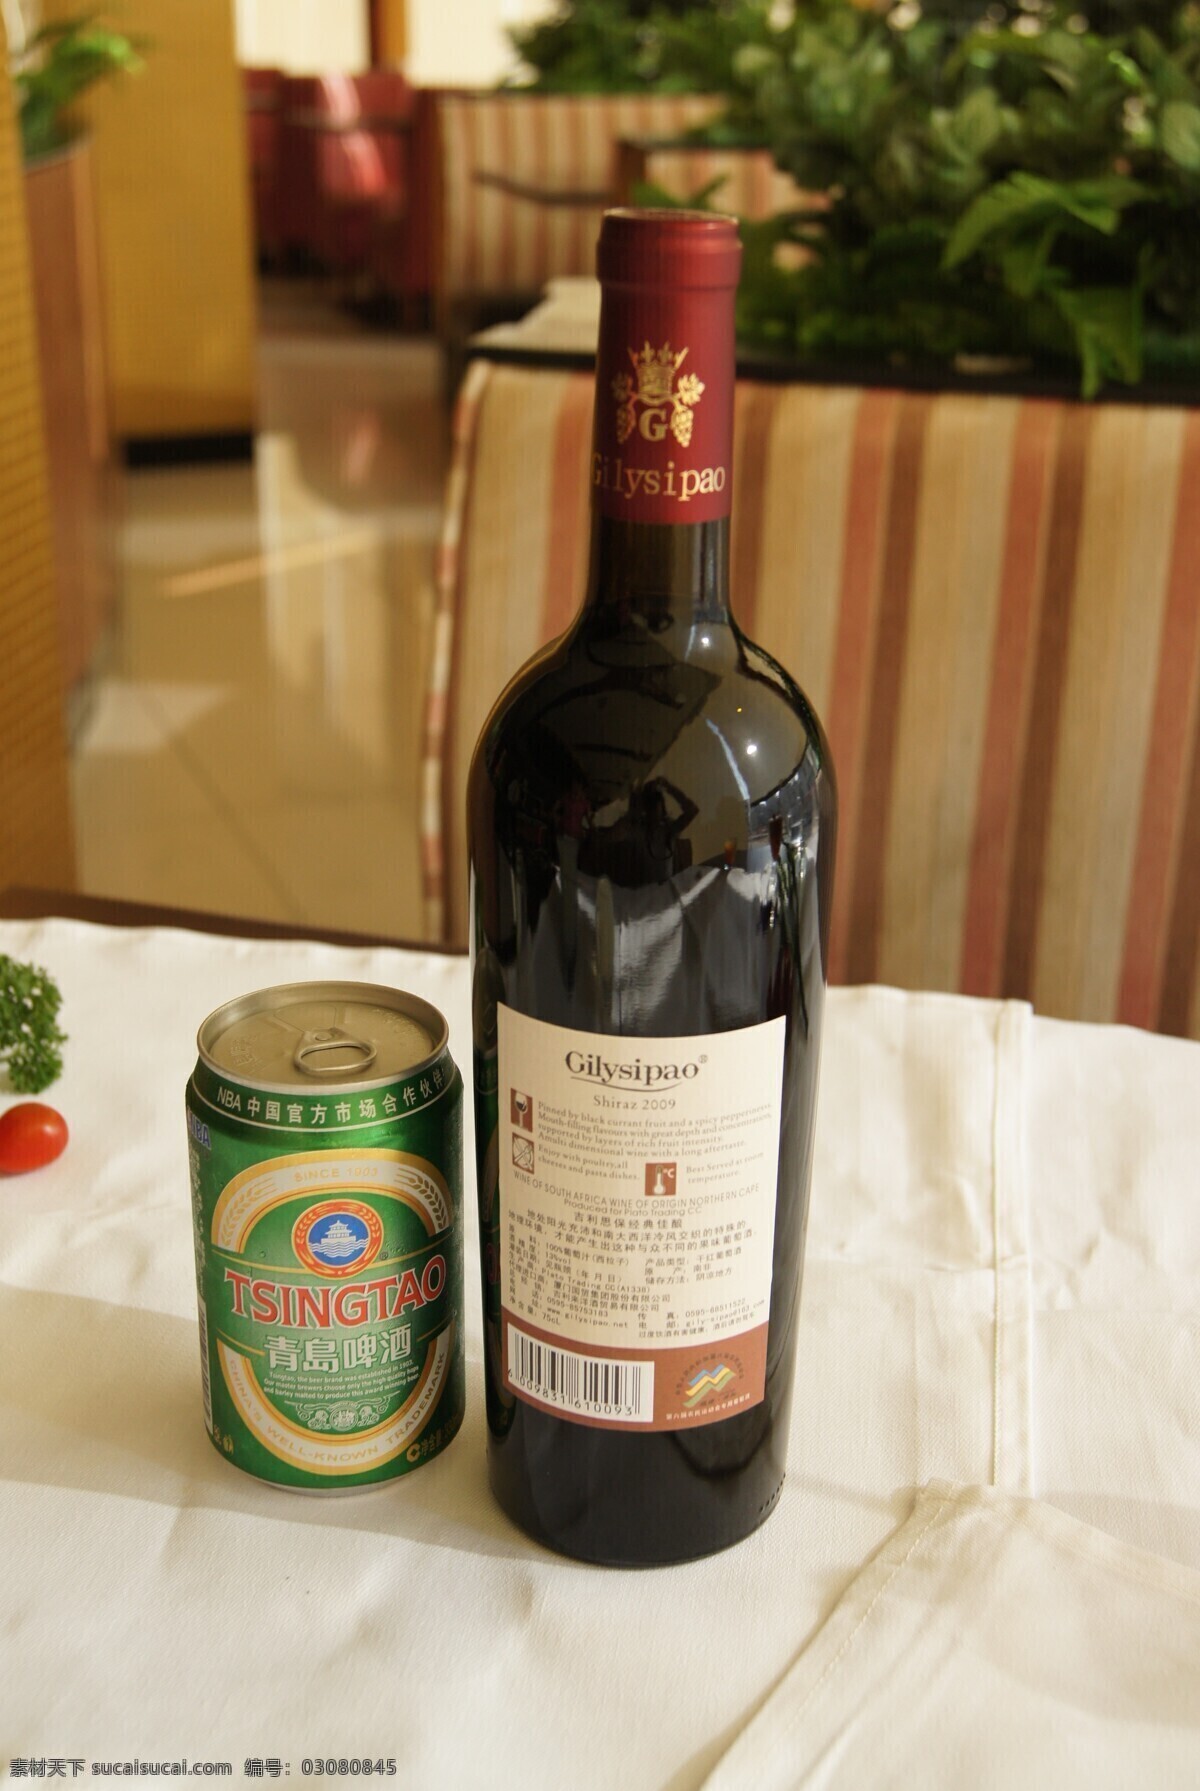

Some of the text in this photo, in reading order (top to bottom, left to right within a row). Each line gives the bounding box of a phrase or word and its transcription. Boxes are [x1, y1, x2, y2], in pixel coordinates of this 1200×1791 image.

[639, 408, 668, 442] G
[565, 1051, 699, 1085] Gilysipao
[217, 1086, 241, 1111] NBA
[593, 1095, 676, 1111] Shiraz 2009
[538, 1112, 591, 1134] Mouth-filling
[593, 1125, 628, 1137] flavours
[630, 1129, 650, 1137] with
[651, 1130, 675, 1139] great
[676, 1128, 700, 1139] depth
[703, 1126, 717, 1135] and
[568, 1110, 579, 1121] by
[581, 1112, 604, 1124] black
[607, 1118, 642, 1127] currant
[645, 1119, 667, 1128] fruit
[669, 1118, 686, 1127] and
[695, 1116, 718, 1128] spicy
[538, 1123, 579, 1140] supported
[582, 1134, 593, 1144] by
[595, 1136, 622, 1147] layers
[625, 1139, 634, 1147] of
[637, 1139, 656, 1147] rich
[658, 1139, 678, 1147] fruit
[538, 1144, 560, 1158] Enjoy
[562, 1153, 581, 1162] with
[568, 1140, 623, 1156] dimensional
[627, 1148, 648, 1157] wine
[651, 1149, 672, 1157] with
[681, 1146, 702, 1157] long
[294, 1167, 340, 1183] SINCE
[568, 1165, 583, 1174] and
[585, 1168, 607, 1178] pasta
[686, 1165, 705, 1174] Best
[707, 1160, 734, 1171] Served
[513, 1170, 759, 1209] WINE OF SOUTH AFRICA WINE OF ORIGIN NORTHERN CAPE
[564, 1198, 608, 1214] Produced
[610, 1207, 623, 1215] for
[650, 1208, 685, 1217] Trading
[688, 1206, 702, 1215] CC
[225, 1255, 446, 1329] TSINGTAO
[264, 1324, 411, 1374] 青島啤酒
[276, 1380, 296, 1389] master
[297, 1383, 322, 1391] brewers
[324, 1383, 346, 1391] choose
[347, 1381, 361, 1391] only
[361, 1379, 372, 1388] the
[373, 1376, 385, 1386] high
[324, 1375, 342, 1383] brand
[358, 1368, 392, 1380] established
[263, 1386, 274, 1394] and
[275, 1387, 293, 1398] barley
[295, 1391, 316, 1399] malted
[325, 1390, 350, 1401] produce
[351, 1389, 363, 1397] this
[365, 1385, 384, 1394] award
[385, 1379, 406, 1391] winning
[266, 1425, 379, 1463] WELL-KNOWN
[385, 1352, 445, 1444] TRADEMARK
